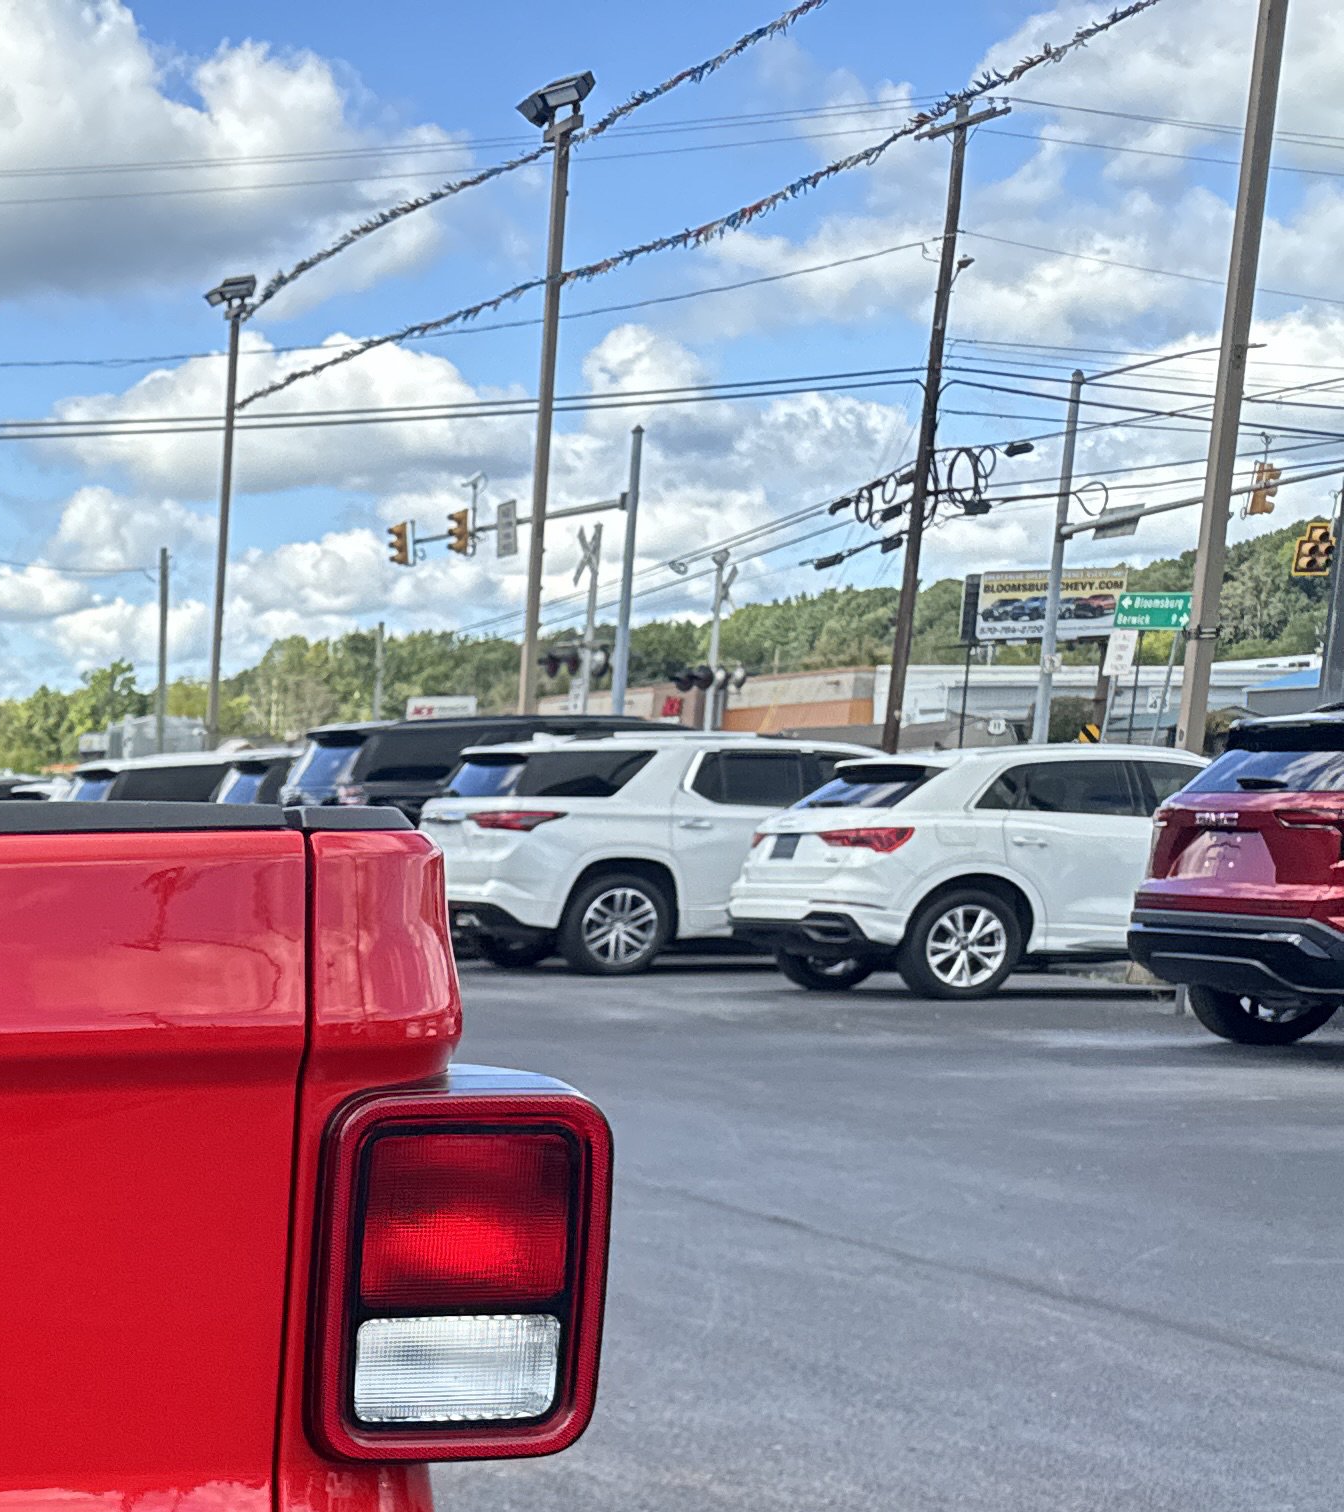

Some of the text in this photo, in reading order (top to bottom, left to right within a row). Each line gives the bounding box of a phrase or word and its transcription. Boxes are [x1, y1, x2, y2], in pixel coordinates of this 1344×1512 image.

[983, 580, 1124, 594] BLOOMSBURCHEVY.COM
[1134, 596, 1184, 610] Bloomsburg
[1116, 612, 1150, 625] Berwick
